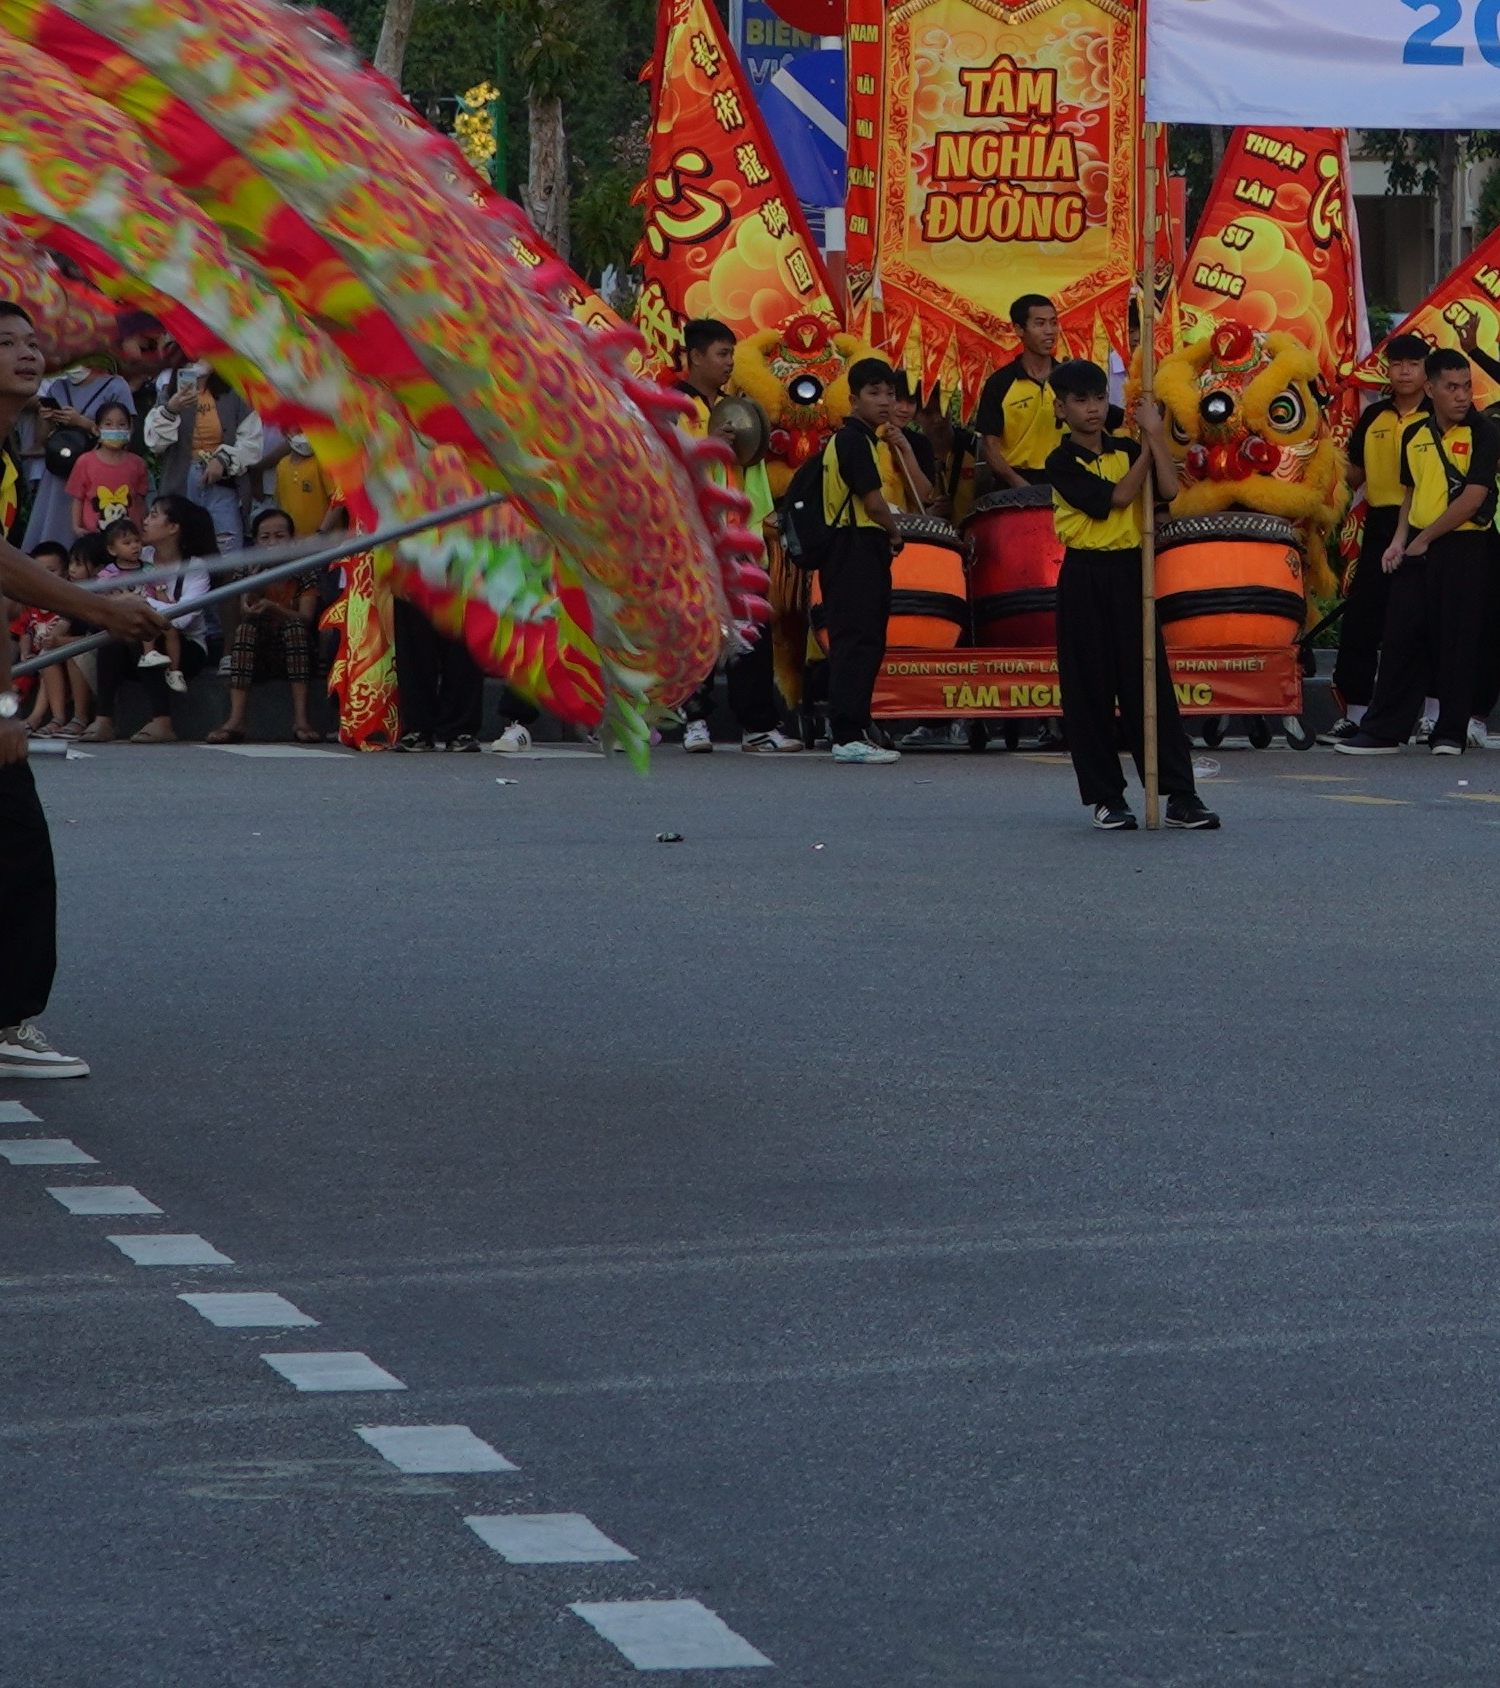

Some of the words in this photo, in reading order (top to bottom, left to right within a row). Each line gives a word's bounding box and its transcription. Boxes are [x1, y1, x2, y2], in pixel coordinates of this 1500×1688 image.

[851, 24, 878, 42] NAM
[962, 57, 1053, 113] TÂM
[937, 123, 1076, 178] NGHĨA
[1245, 132, 1305, 170] THUẬT
[1235, 178, 1276, 207] LÂN
[849, 214, 868, 235] GHI
[925, 182, 1084, 238] ĐƯỜNG
[887, 659, 931, 675] ĐOÀN
[935, 659, 978, 676] NGHỆ
[1039, 658, 1060, 673] LÂ
[1175, 659, 1217, 672] PHAN
[1222, 655, 1267, 671] THIẾT
[943, 681, 999, 708] TÂM
